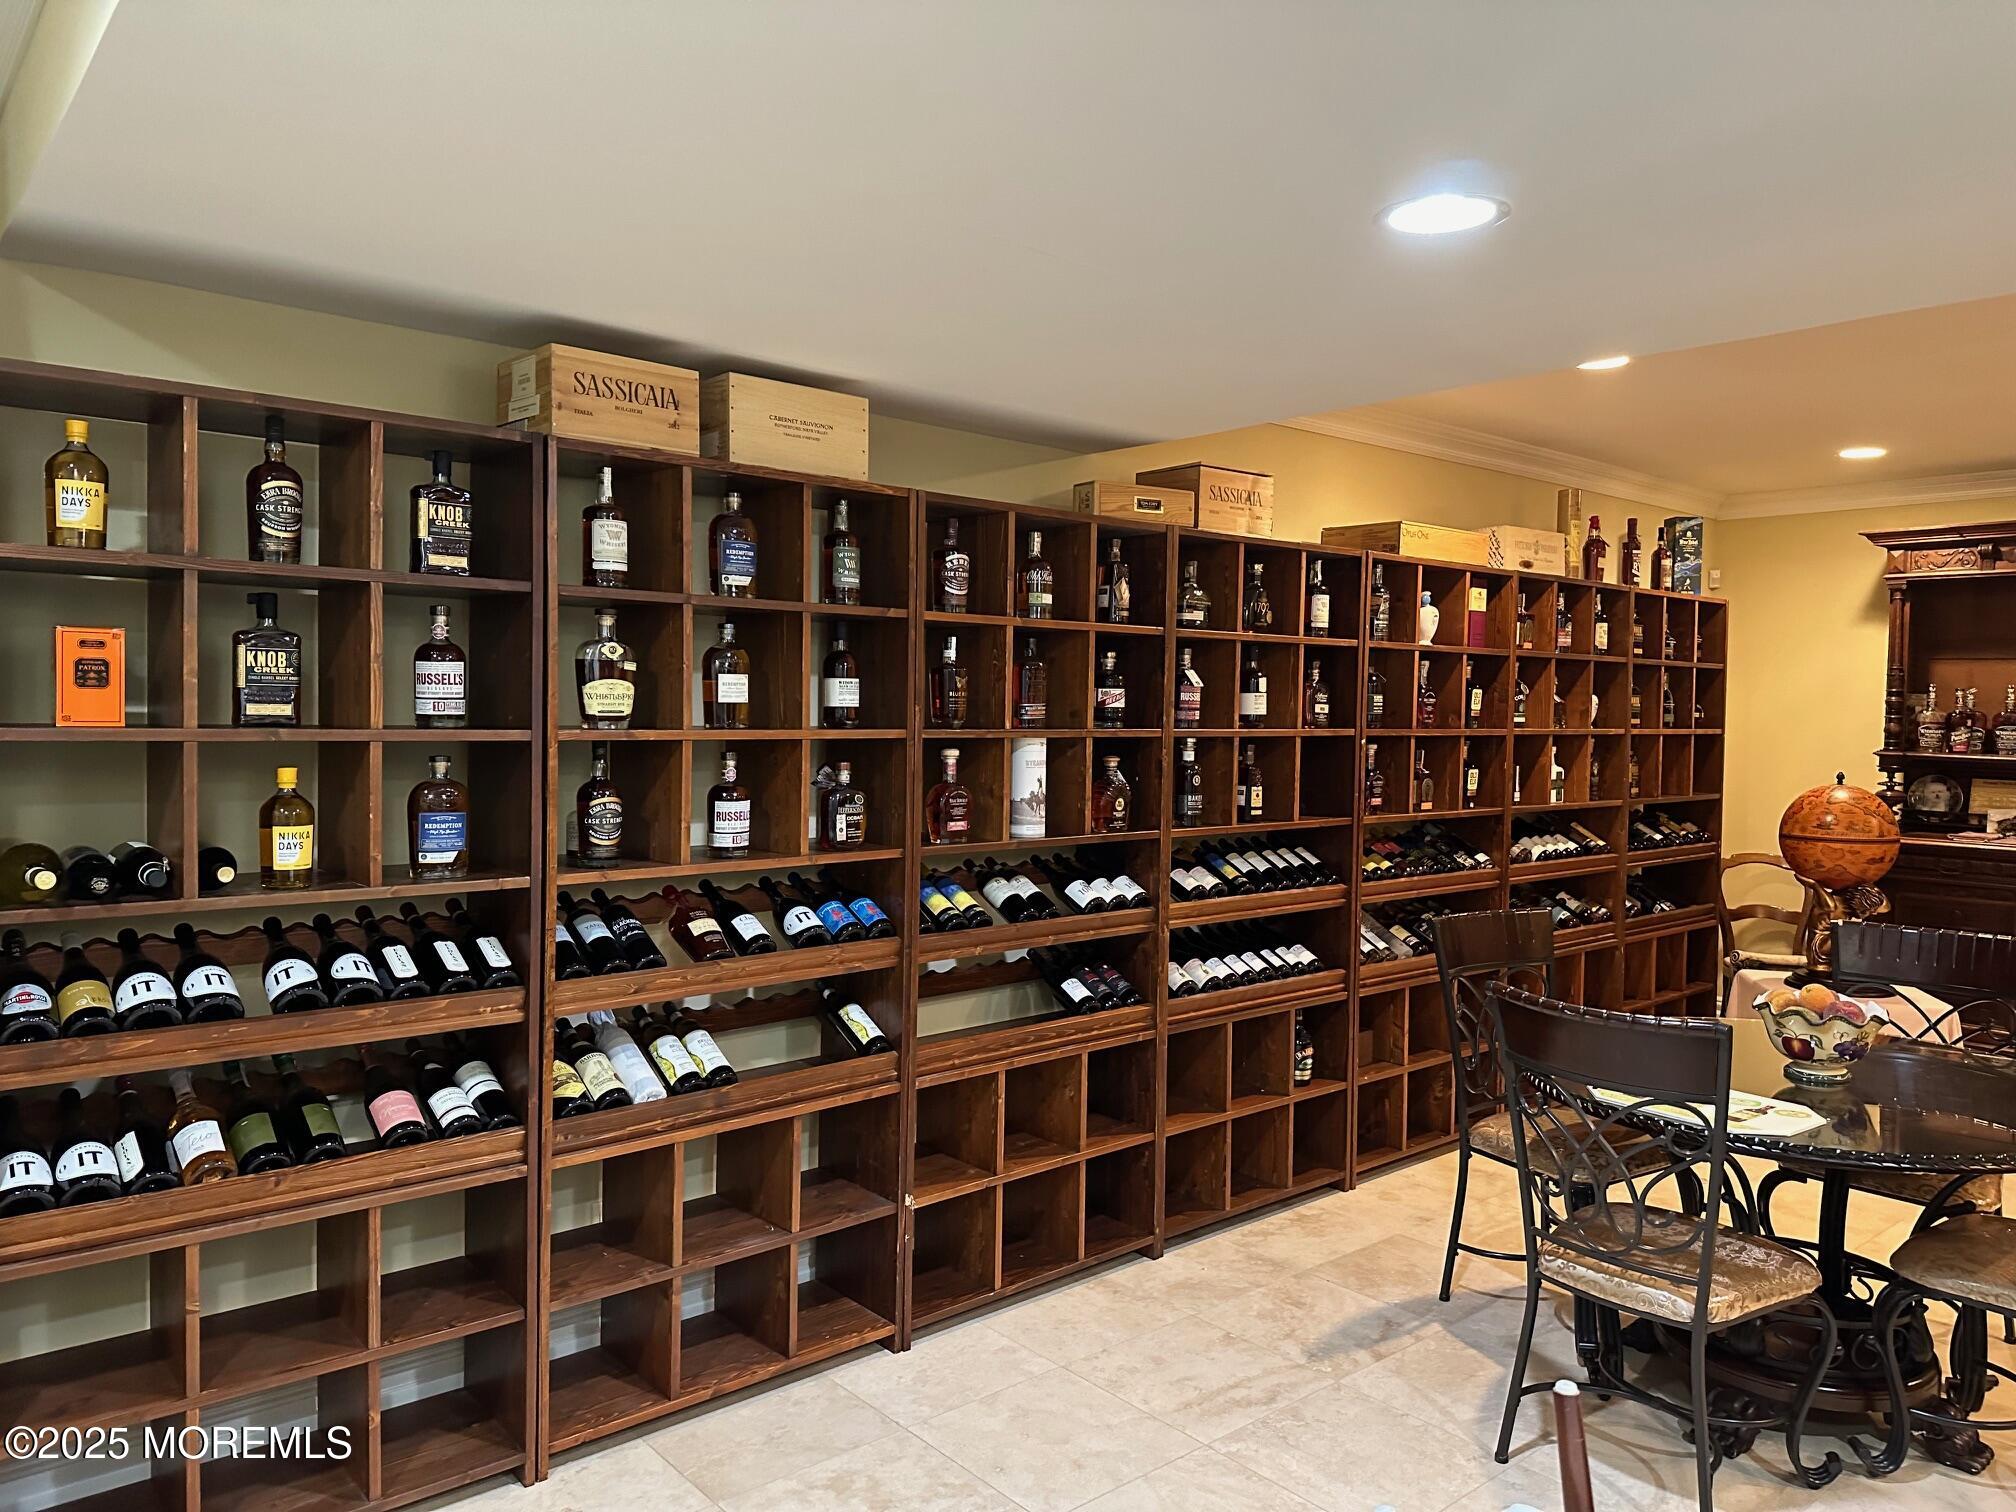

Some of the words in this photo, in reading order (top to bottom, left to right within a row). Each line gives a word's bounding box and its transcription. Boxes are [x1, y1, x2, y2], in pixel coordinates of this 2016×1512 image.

[573, 371, 680, 412] SASSICAIA
[574, 408, 594, 417] ITALIA
[614, 406, 644, 415] BOLGHERI
[769, 415, 799, 425] CABERNET
[799, 419, 834, 431] SAUVIGNON
[61, 486, 100, 499] NIKKA
[1209, 485, 1262, 507] SASSICAIA
[61, 496, 91, 508] DAYS
[254, 504, 275, 513] CASK
[428, 504, 464, 523] KNOB
[434, 520, 471, 529] CREEK
[246, 650, 288, 668] KNOB
[416, 673, 464, 686] RUSSELL'S
[433, 702, 446, 712] 10
[278, 831, 311, 841] NIKKA
[278, 842, 304, 851] DAYS
[795, 912, 811, 924] IT
[352, 960, 371, 973] IT
[204, 973, 227, 986] IT
[273, 966, 295, 986] IT
[131, 979, 156, 996] IT
[78, 1151, 103, 1167] IT
[9, 1161, 36, 1178] IT
